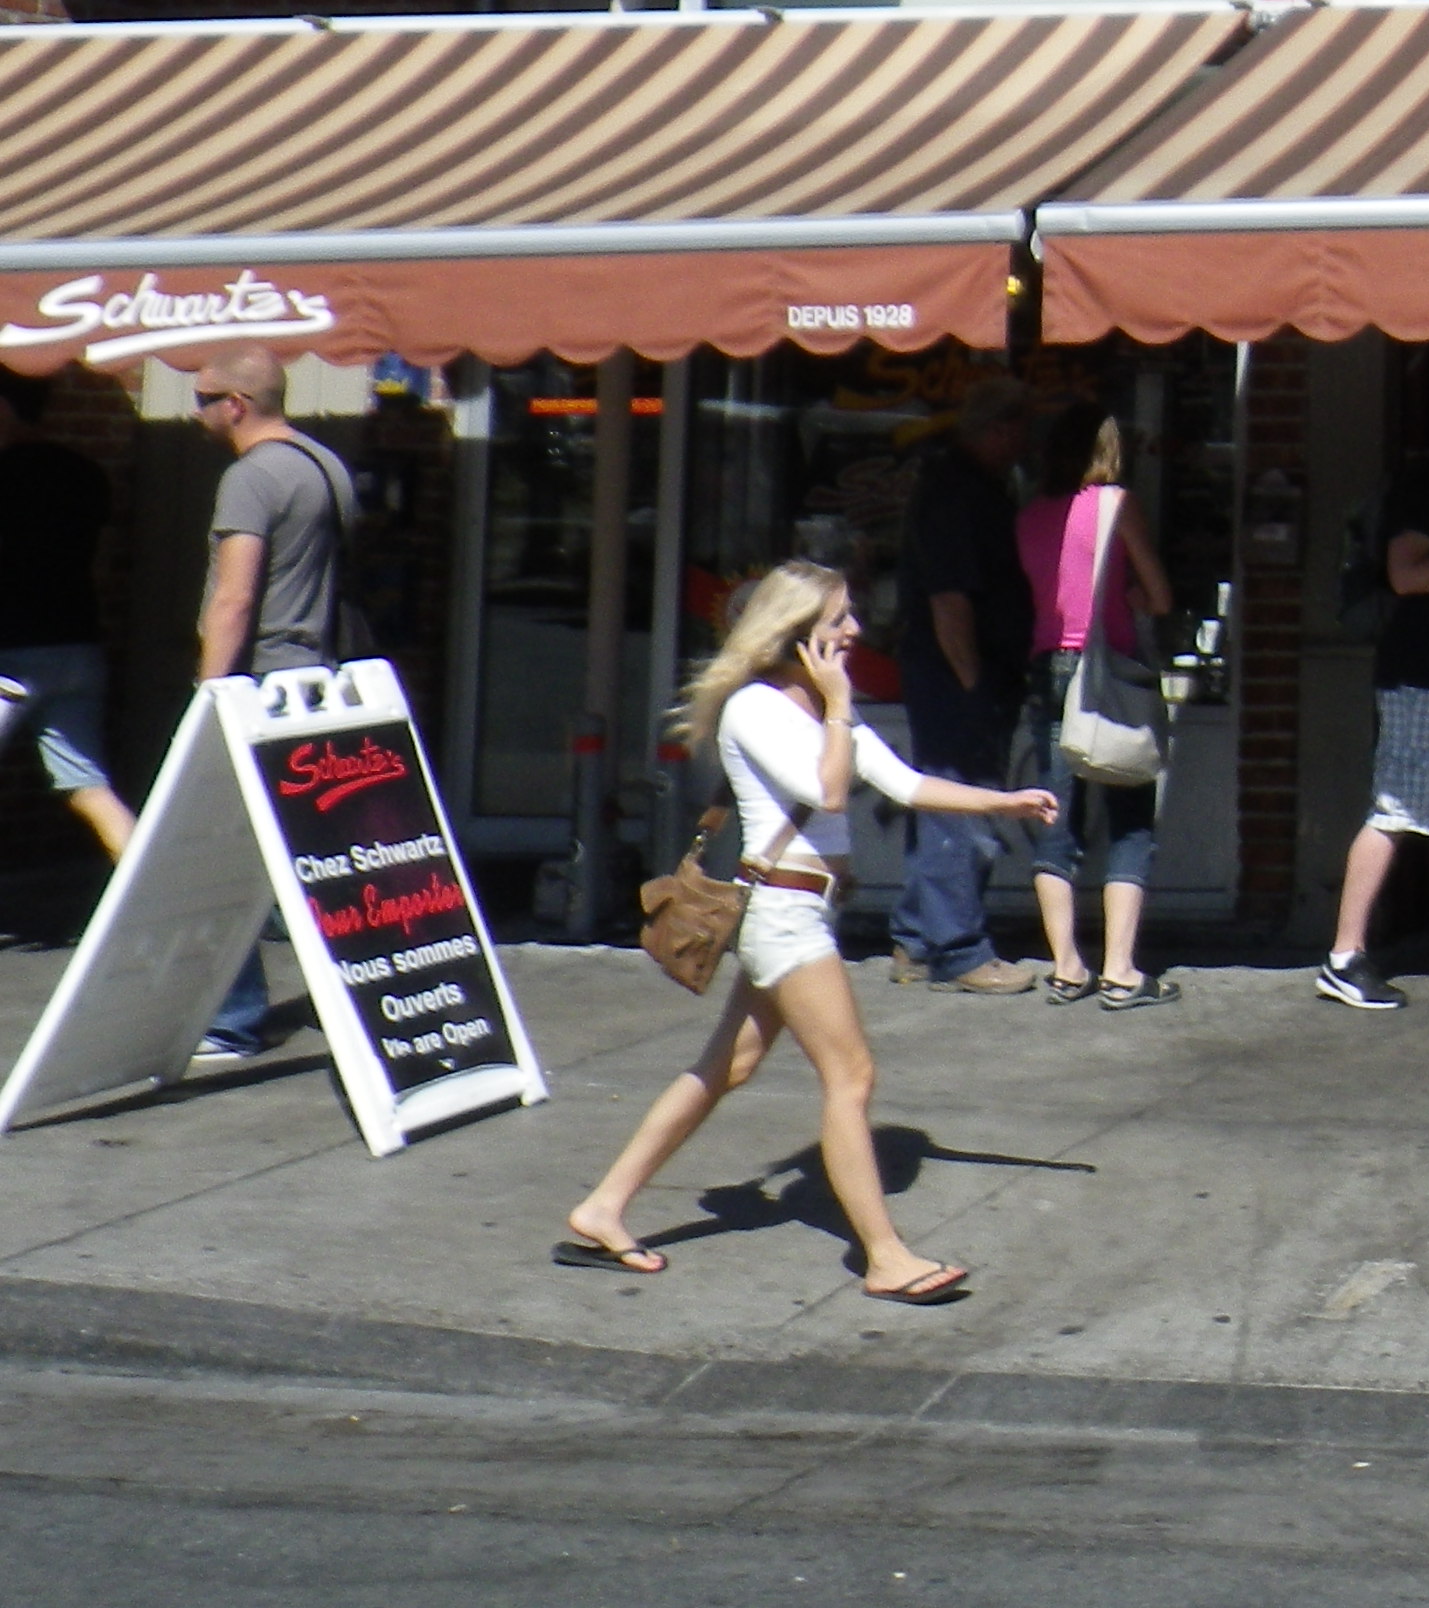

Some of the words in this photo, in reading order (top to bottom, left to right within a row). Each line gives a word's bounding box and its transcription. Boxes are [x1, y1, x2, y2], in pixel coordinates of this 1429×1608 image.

[0, 269, 336, 363] Schwartz's
[787, 304, 860, 329] DEPUIS
[863, 303, 915, 329] 1928
[295, 855, 352, 883] Chez
[350, 833, 447, 872] Schwartz
[391, 935, 480, 973] sommes
[381, 981, 465, 1023] Ouverts
[412, 1032, 444, 1054] are
[442, 1017, 492, 1046] Open
